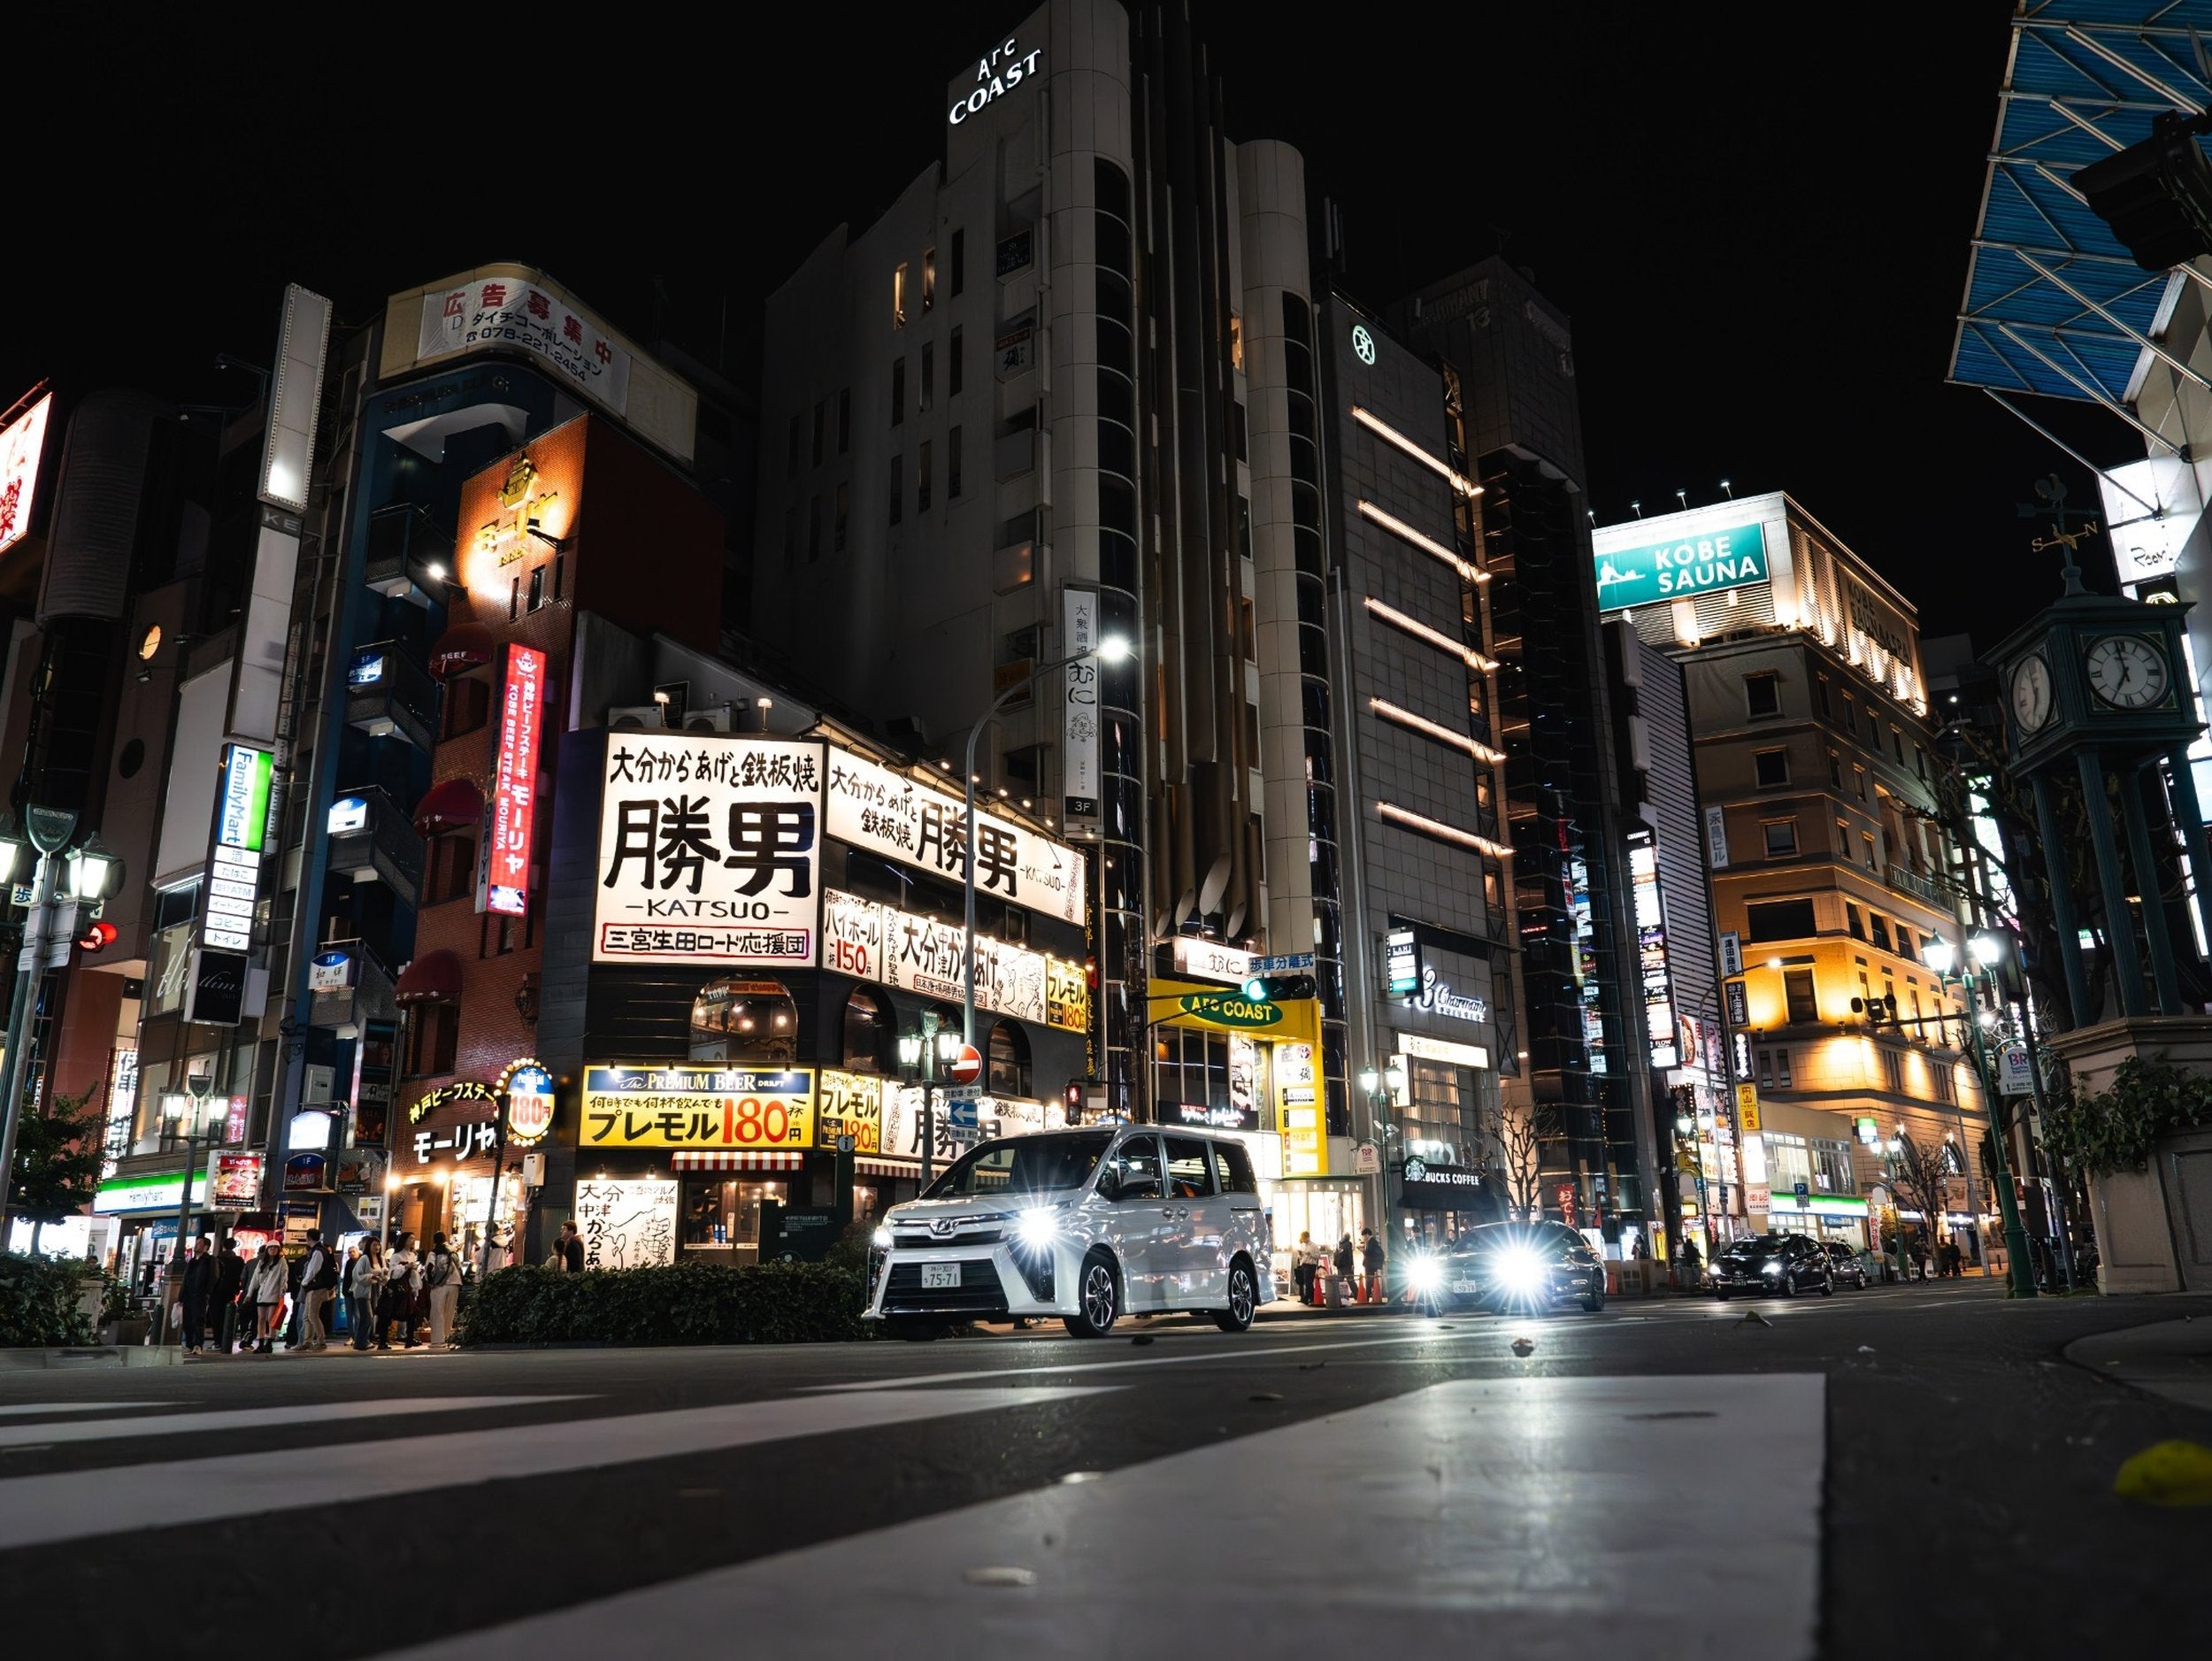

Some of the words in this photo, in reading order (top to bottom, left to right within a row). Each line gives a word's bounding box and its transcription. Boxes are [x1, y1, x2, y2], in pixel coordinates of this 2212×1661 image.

[978, 39, 1015, 81] Arc
[949, 50, 1041, 125] COAST
[443, 284, 612, 365] 広告募集中
[1655, 535, 1732, 571] KOBE
[1657, 556, 1760, 593] SAUNA
[506, 684, 519, 716] KOBE
[504, 718, 516, 751] BEEF
[502, 753, 513, 790] STEAK
[611, 746, 818, 793] 大分からあげと鉄板焼
[226, 751, 252, 843] FamilyMart
[831, 765, 918, 822] 大分からあげと
[1074, 801, 1091, 813] 3F
[495, 796, 510, 850] MOURIYA
[504, 784, 530, 875] モーリヤ
[861, 807, 914, 851] 鉄板焼
[603, 795, 815, 898] 勝男
[916, 798, 1017, 897] 勝男
[606, 928, 805, 955] 三宮生田ロード応援団
[825, 907, 879, 947] ハイボール
[1249, 953, 1315, 973] 歩車分離式
[1223, 1000, 1273, 1021] COAST
[648, 1072, 710, 1091] PREMIUM
[714, 1073, 757, 1091] BEER
[409, 1082, 497, 1122] 神戸ビーフステー
[589, 1096, 723, 1109] 何時でも何杯飲んでも
[413, 1122, 495, 1164] モーリヤ
[588, 1109, 719, 1142] プレモル
[580, 1184, 625, 1202] 大分
[1452, 1173, 1480, 1186] COFFEE
[579, 1203, 612, 1219] 中津
[1559, 1190, 1575, 1226] おでん
[930, 1273, 957, 1286] 75-71
